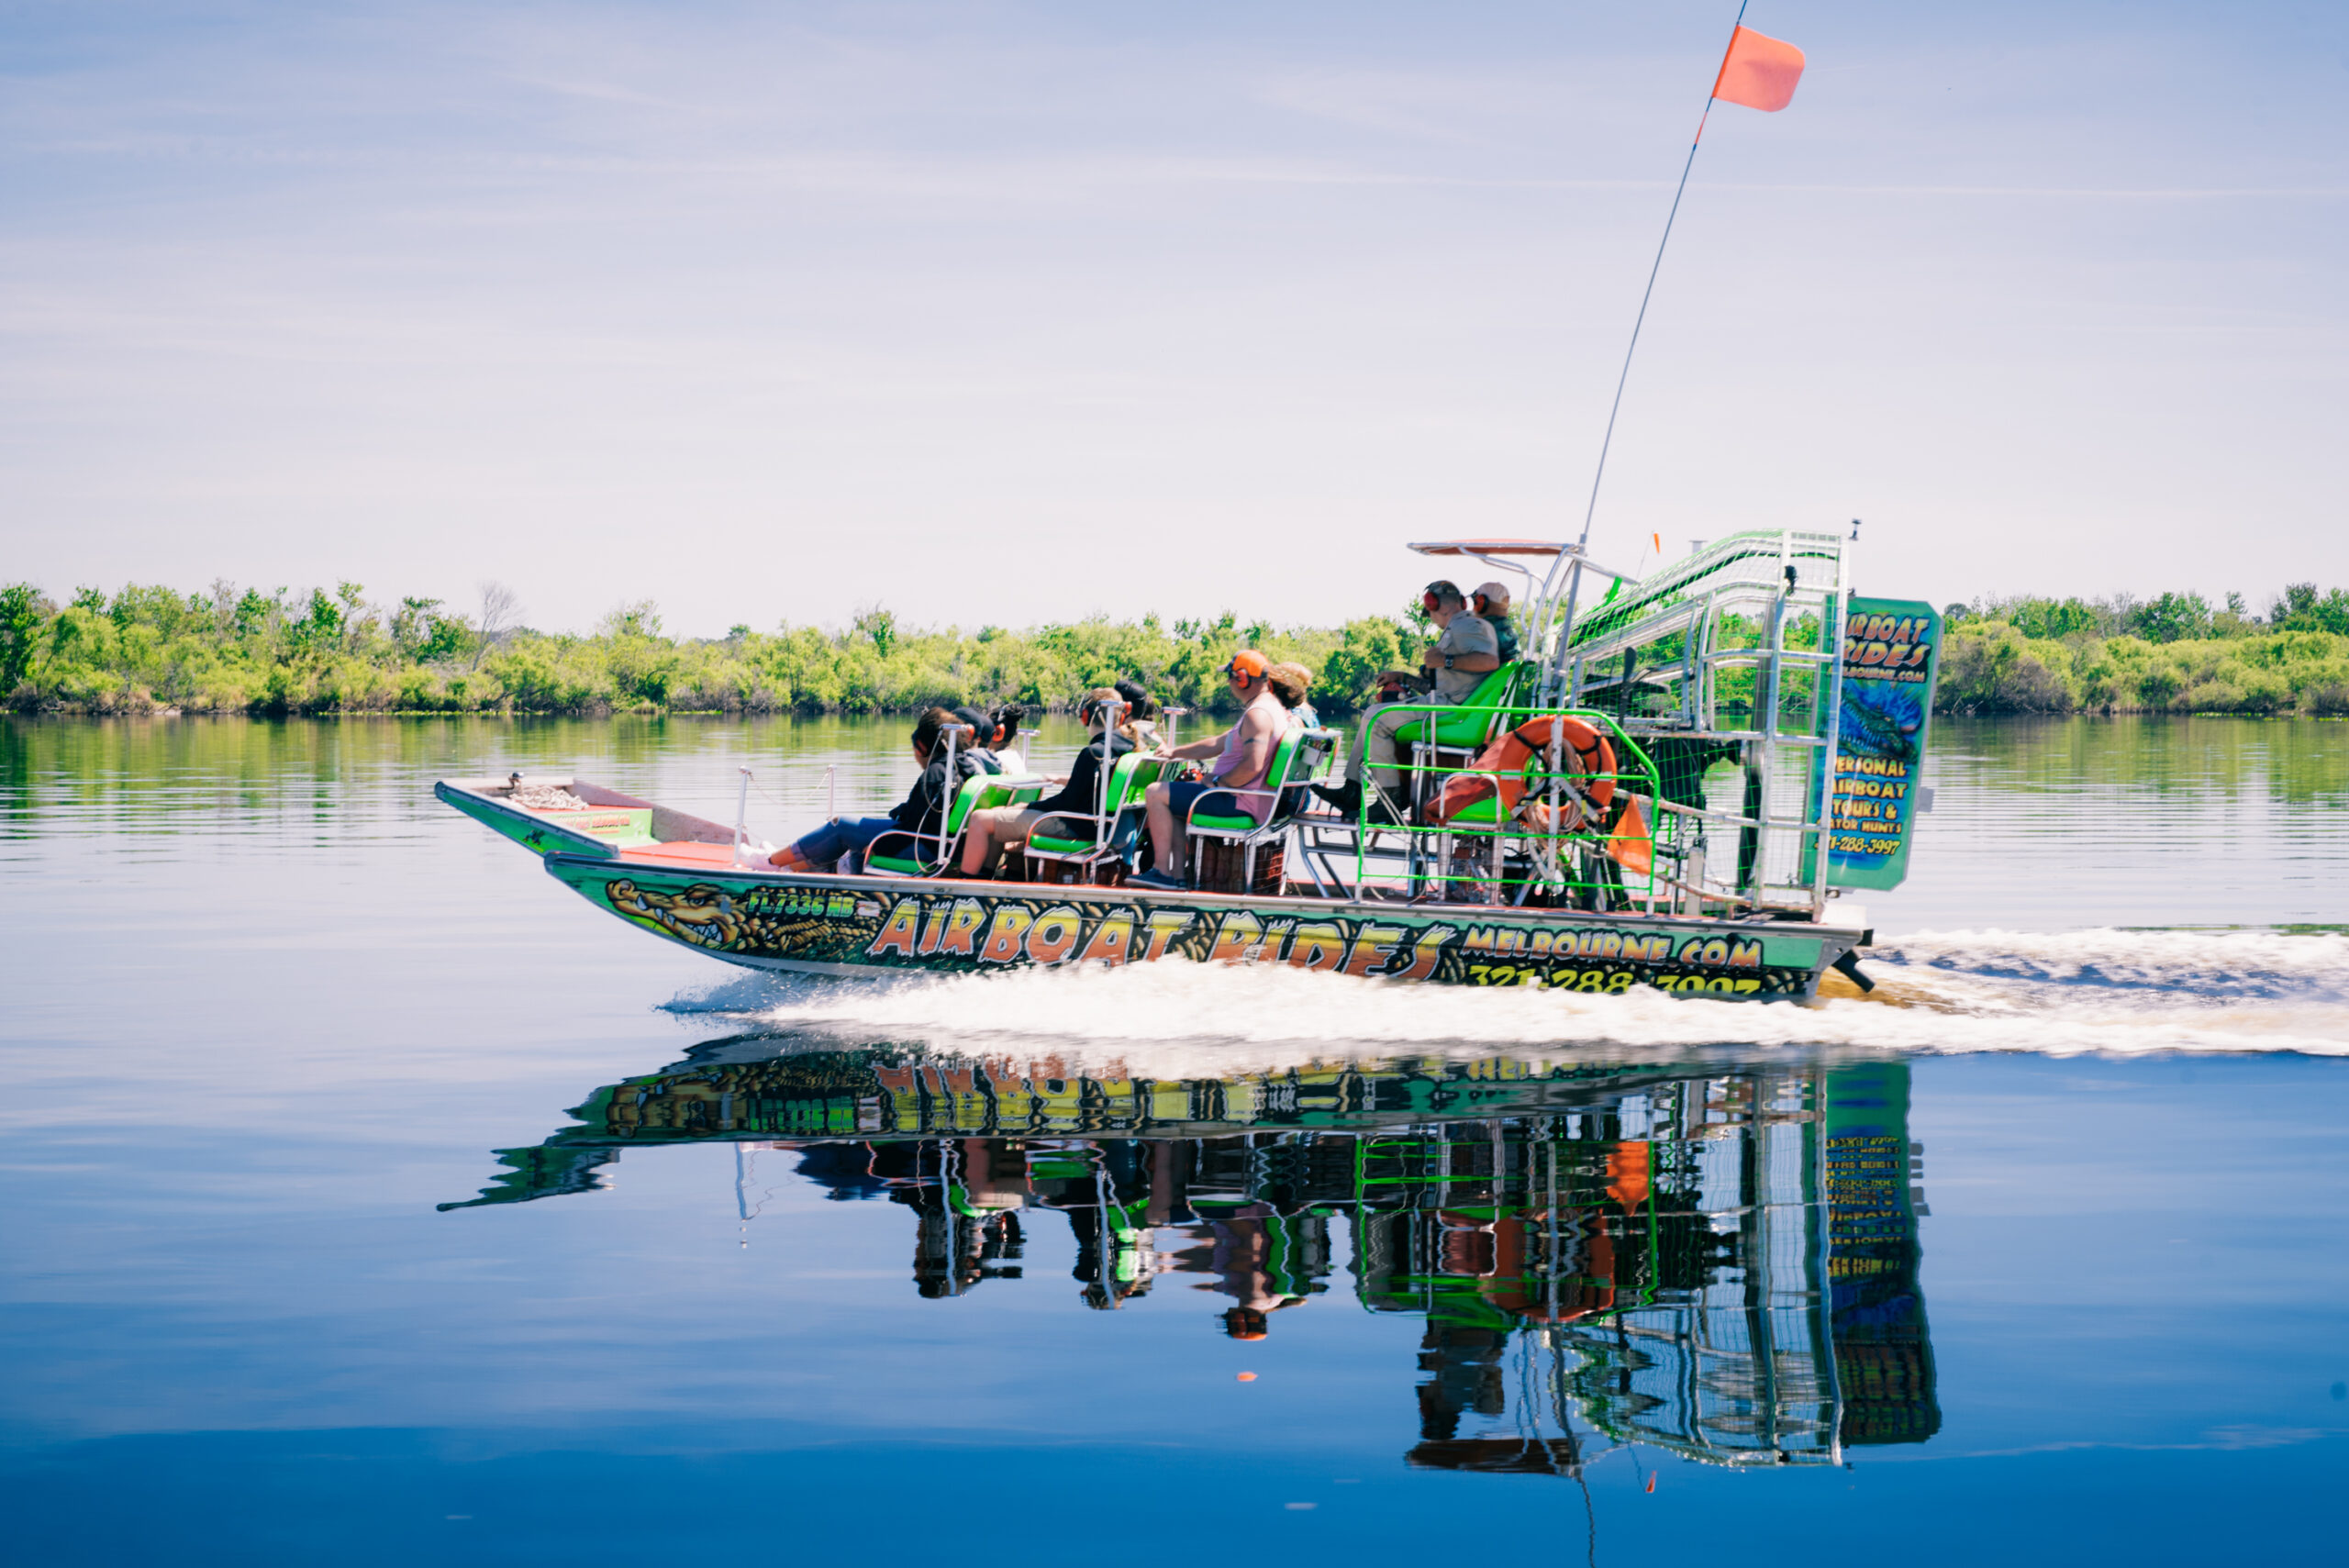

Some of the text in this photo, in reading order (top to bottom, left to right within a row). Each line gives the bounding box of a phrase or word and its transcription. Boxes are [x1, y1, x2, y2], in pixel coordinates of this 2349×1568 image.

[1845, 613, 1931, 644] IRBOAT
[1835, 755, 1907, 777] ERSONAL
[1831, 798, 1898, 819] TOURS &
[1860, 820, 1901, 834] HUNTS
[1814, 835, 1901, 855] 1-288-3997
[865, 896, 1458, 981] AIRBOAT RIDES
[1460, 924, 1763, 968] MELBOURNE.COM
